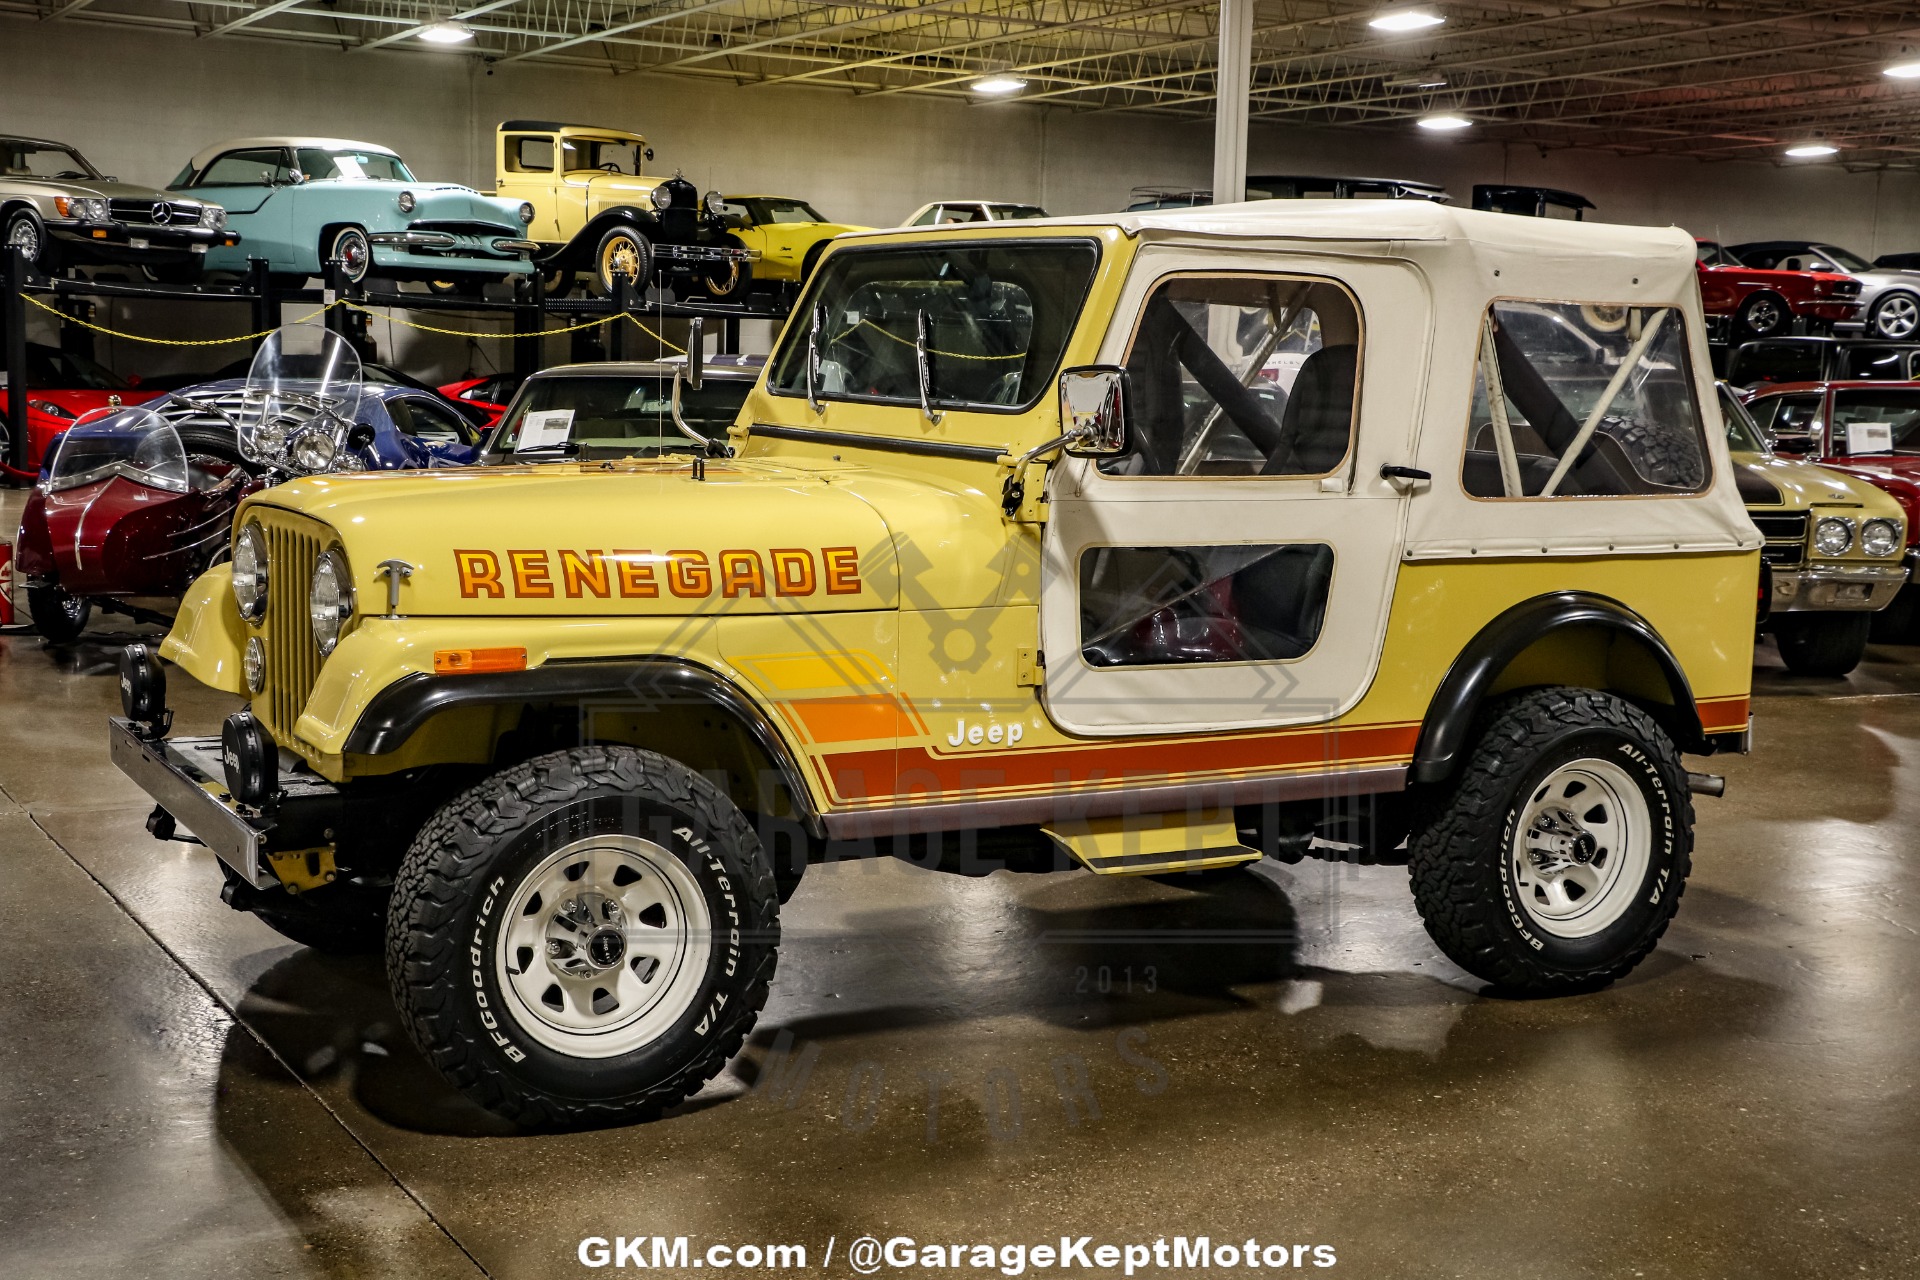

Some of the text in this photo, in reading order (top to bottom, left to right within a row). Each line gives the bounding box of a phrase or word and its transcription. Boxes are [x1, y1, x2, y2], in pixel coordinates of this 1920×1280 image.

[453, 546, 862, 599] RENEGADE
[120, 671, 131, 697] Jeep
[224, 745, 240, 774] Jeep
[946, 719, 1024, 748] Jeep
[1618, 743, 1675, 905] All-Terrain T/A
[1500, 808, 1545, 951] BFGoodrich
[470, 876, 527, 1064] BFGoodrich
[672, 826, 741, 1036] All-Terrain T/A
